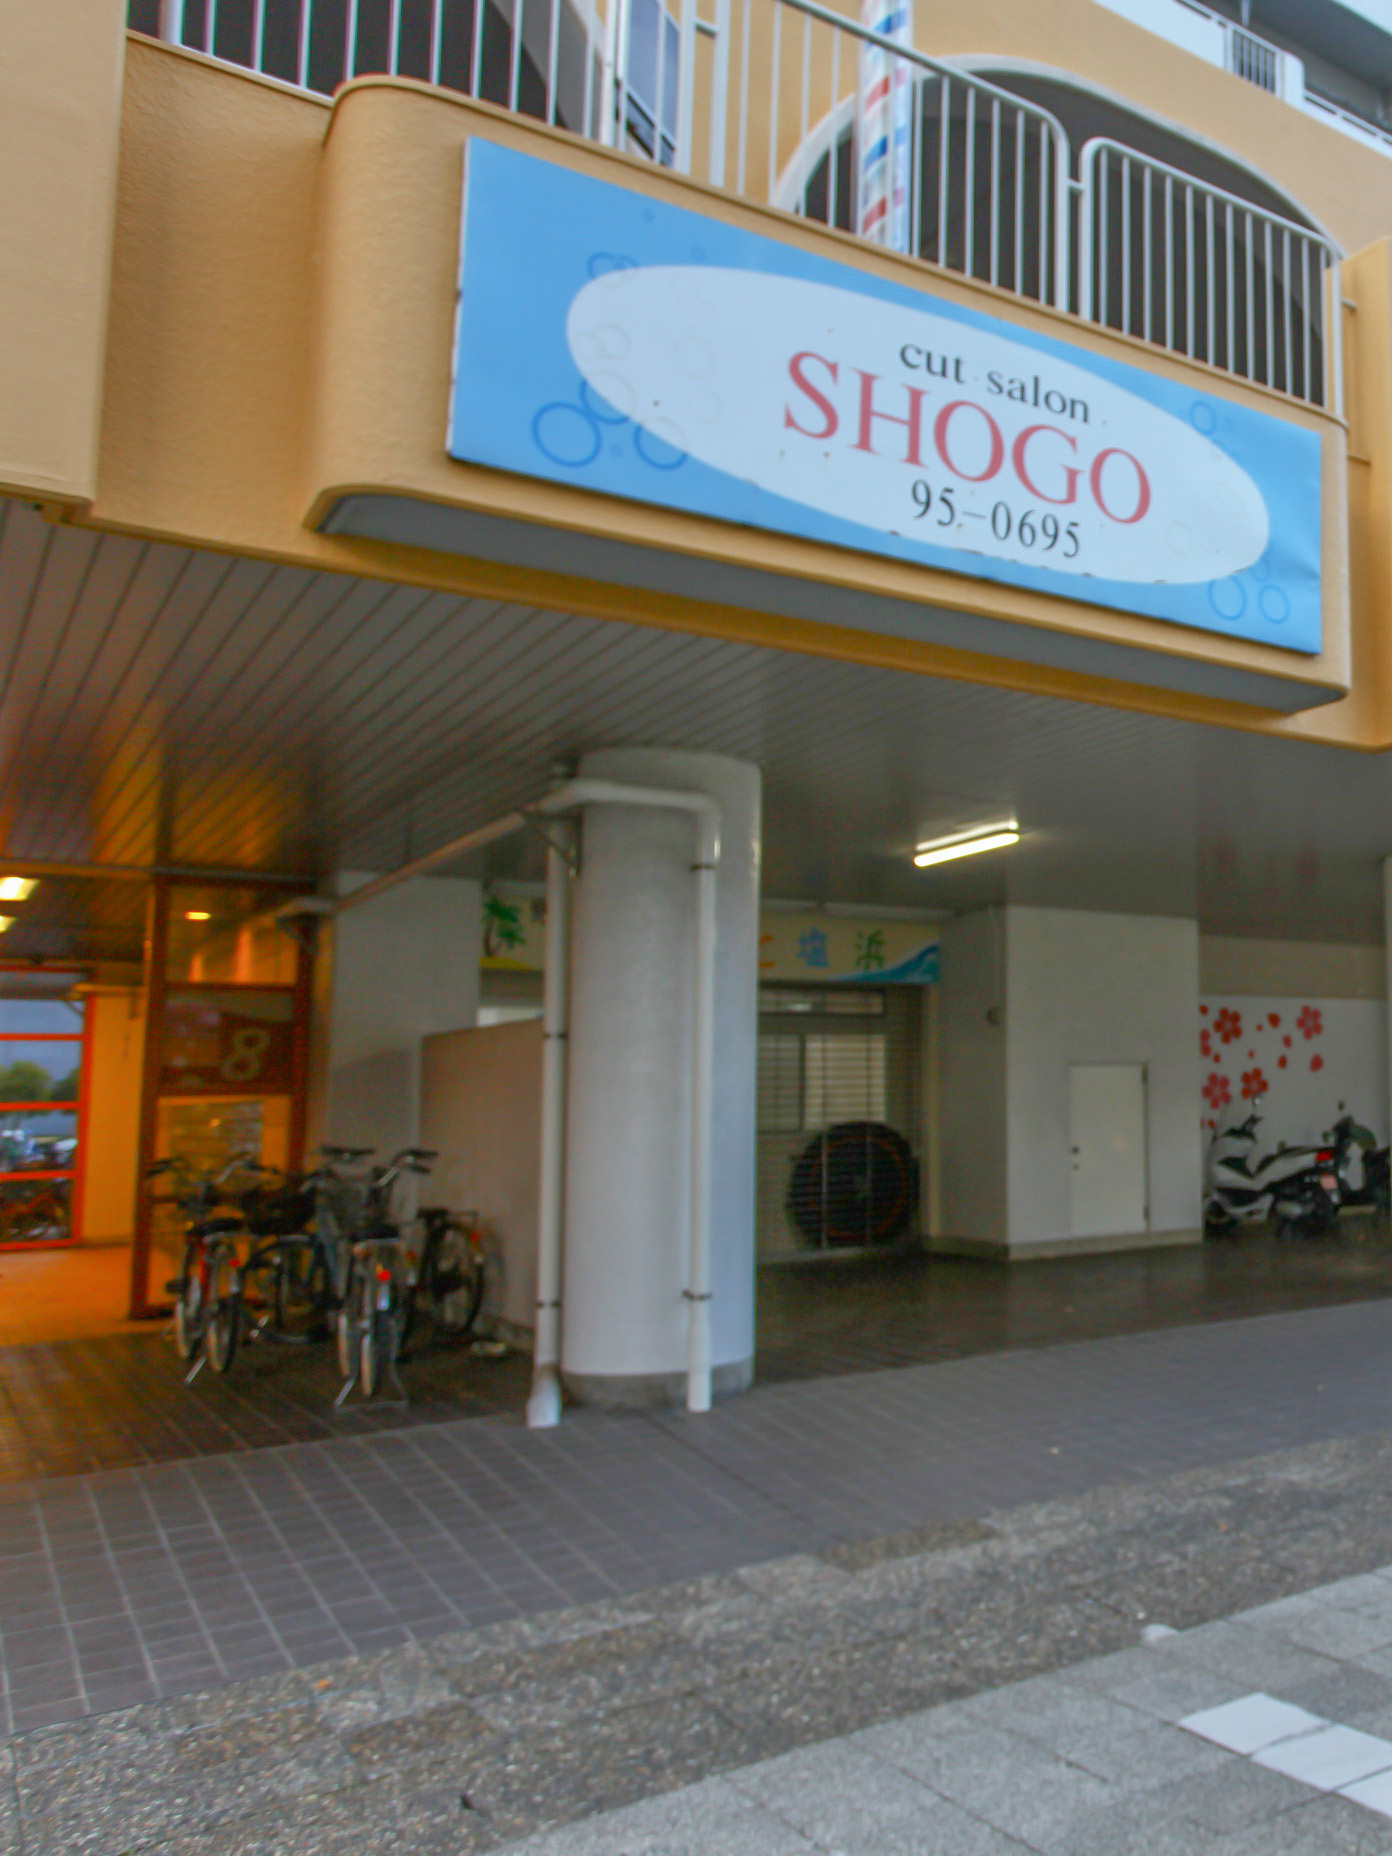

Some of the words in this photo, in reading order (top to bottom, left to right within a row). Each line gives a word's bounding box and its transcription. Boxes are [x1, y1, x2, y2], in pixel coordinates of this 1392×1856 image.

[899, 343, 966, 383] cut
[986, 369, 1089, 424] salon
[784, 351, 1151, 524] SHOGO
[911, 479, 1080, 558] 95-0695
